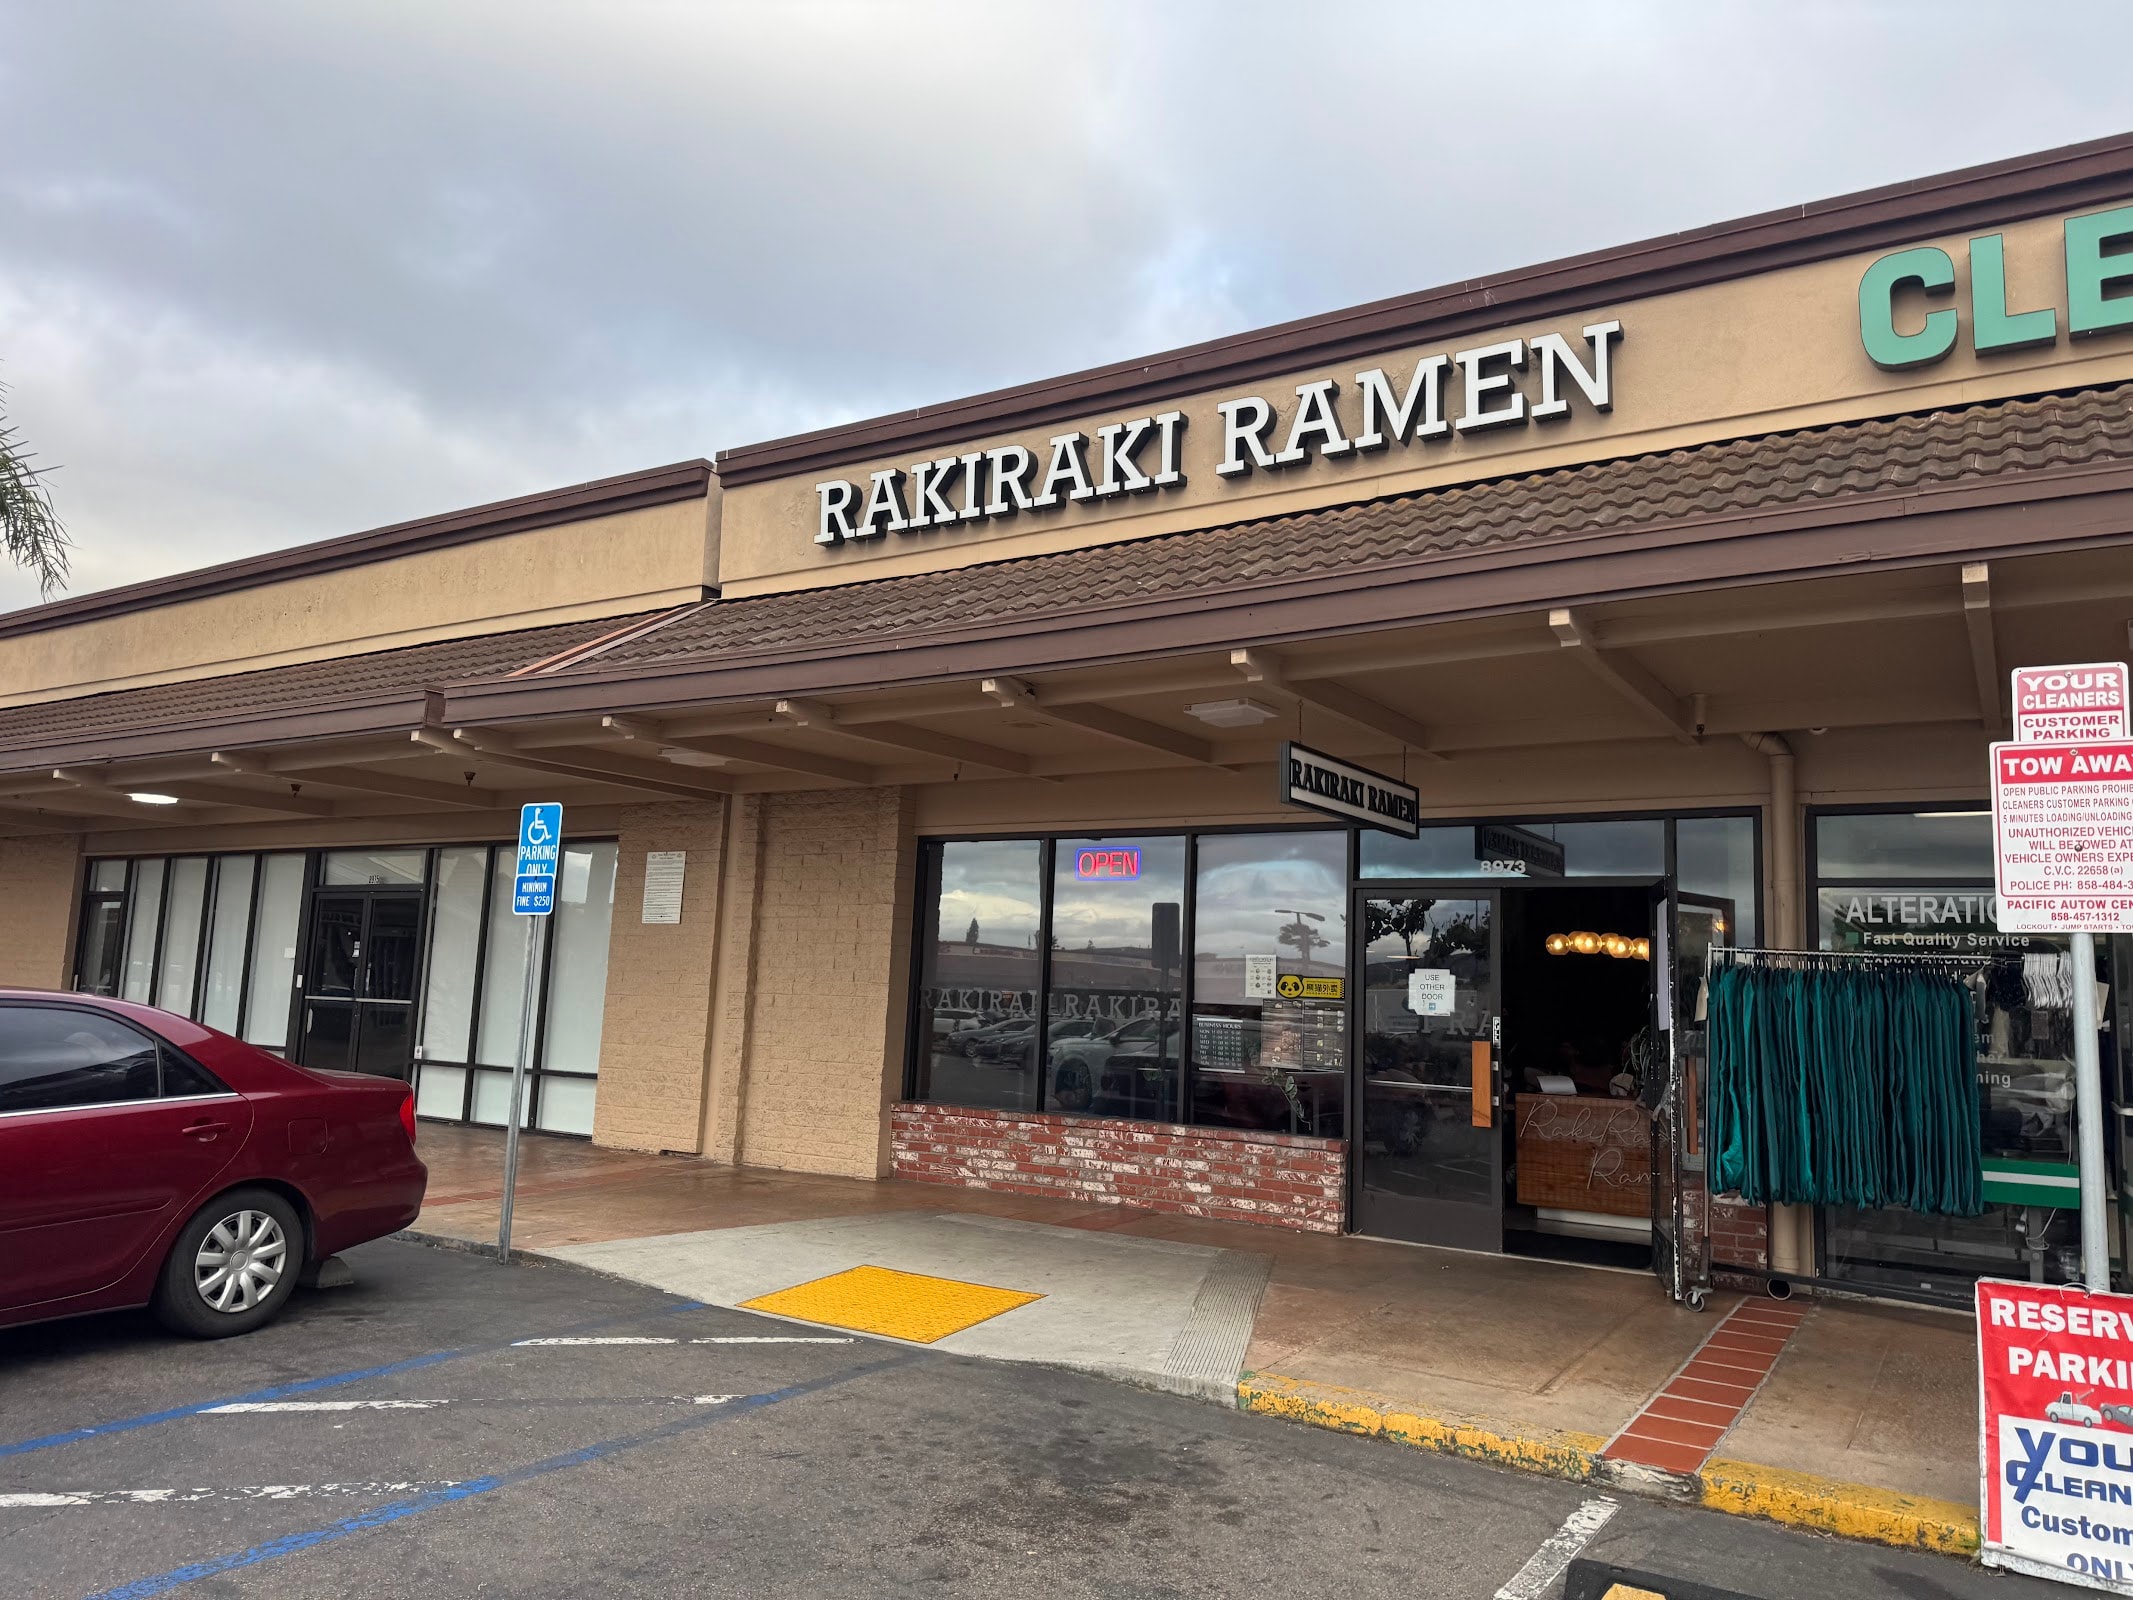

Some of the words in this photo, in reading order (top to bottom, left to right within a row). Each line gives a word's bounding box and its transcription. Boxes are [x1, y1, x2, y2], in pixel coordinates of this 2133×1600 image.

[1858, 206, 2133, 371] CLE
[814, 410, 1186, 546] RAKIRAKI
[1216, 319, 1623, 477] RAMEN
[2021, 672, 2119, 692] YOUR
[2022, 690, 2120, 710] CLEANERS
[2023, 715, 2120, 728] CUSTOMER
[2033, 728, 2111, 740] PARKING
[2003, 756, 2063, 777] TOW
[2070, 754, 2133, 774] AWA
[1290, 758, 1365, 809] RAKIRAKI
[1367, 784, 1416, 825] RAMEN
[2003, 787, 2026, 797] OPEN
[2028, 786, 2059, 796] PUBLIC
[2061, 785, 2100, 795] PARKING
[2002, 799, 2044, 810] CLEANERS
[2046, 798, 2091, 809] CUSTOMER
[2093, 797, 2130, 807] PARKING
[2003, 814, 2008, 824] 5
[2009, 813, 2044, 823] MINUTES
[2046, 811, 2132, 822] LOADING/UNLOADING
[2008, 827, 2095, 838] UNAUTHORIZED
[2097, 825, 2133, 837] VEHIC
[2028, 840, 2056, 851] WILL
[2058, 840, 2073, 850] BE
[2075, 839, 2116, 850] TOWED
[520, 844, 557, 861] PARKING
[2004, 853, 2052, 864] VEHICLE
[2054, 852, 2104, 863] OWNERS
[525, 863, 548, 874] ONLY
[1078, 851, 1138, 878] OPEN
[1480, 859, 1526, 874] 8973
[2043, 865, 2075, 876] C.V.C.
[521, 881, 548, 893] MINIMUM
[2010, 880, 2051, 891] POLICE
[2053, 880, 2072, 891] PH:
[516, 895, 530, 907] FINE
[533, 894, 551, 907] $250
[2007, 899, 2056, 910] PACIFIC
[2060, 899, 2107, 910] AUTOW
[2051, 912, 2120, 921] 858-457-1312
[1863, 931, 1898, 945] Fast
[1902, 932, 1961, 949] Quality
[1967, 932, 2030, 947] Service
[1419, 983, 1445, 991] OTHER
[2008, 1346, 2133, 1391] PARKI
